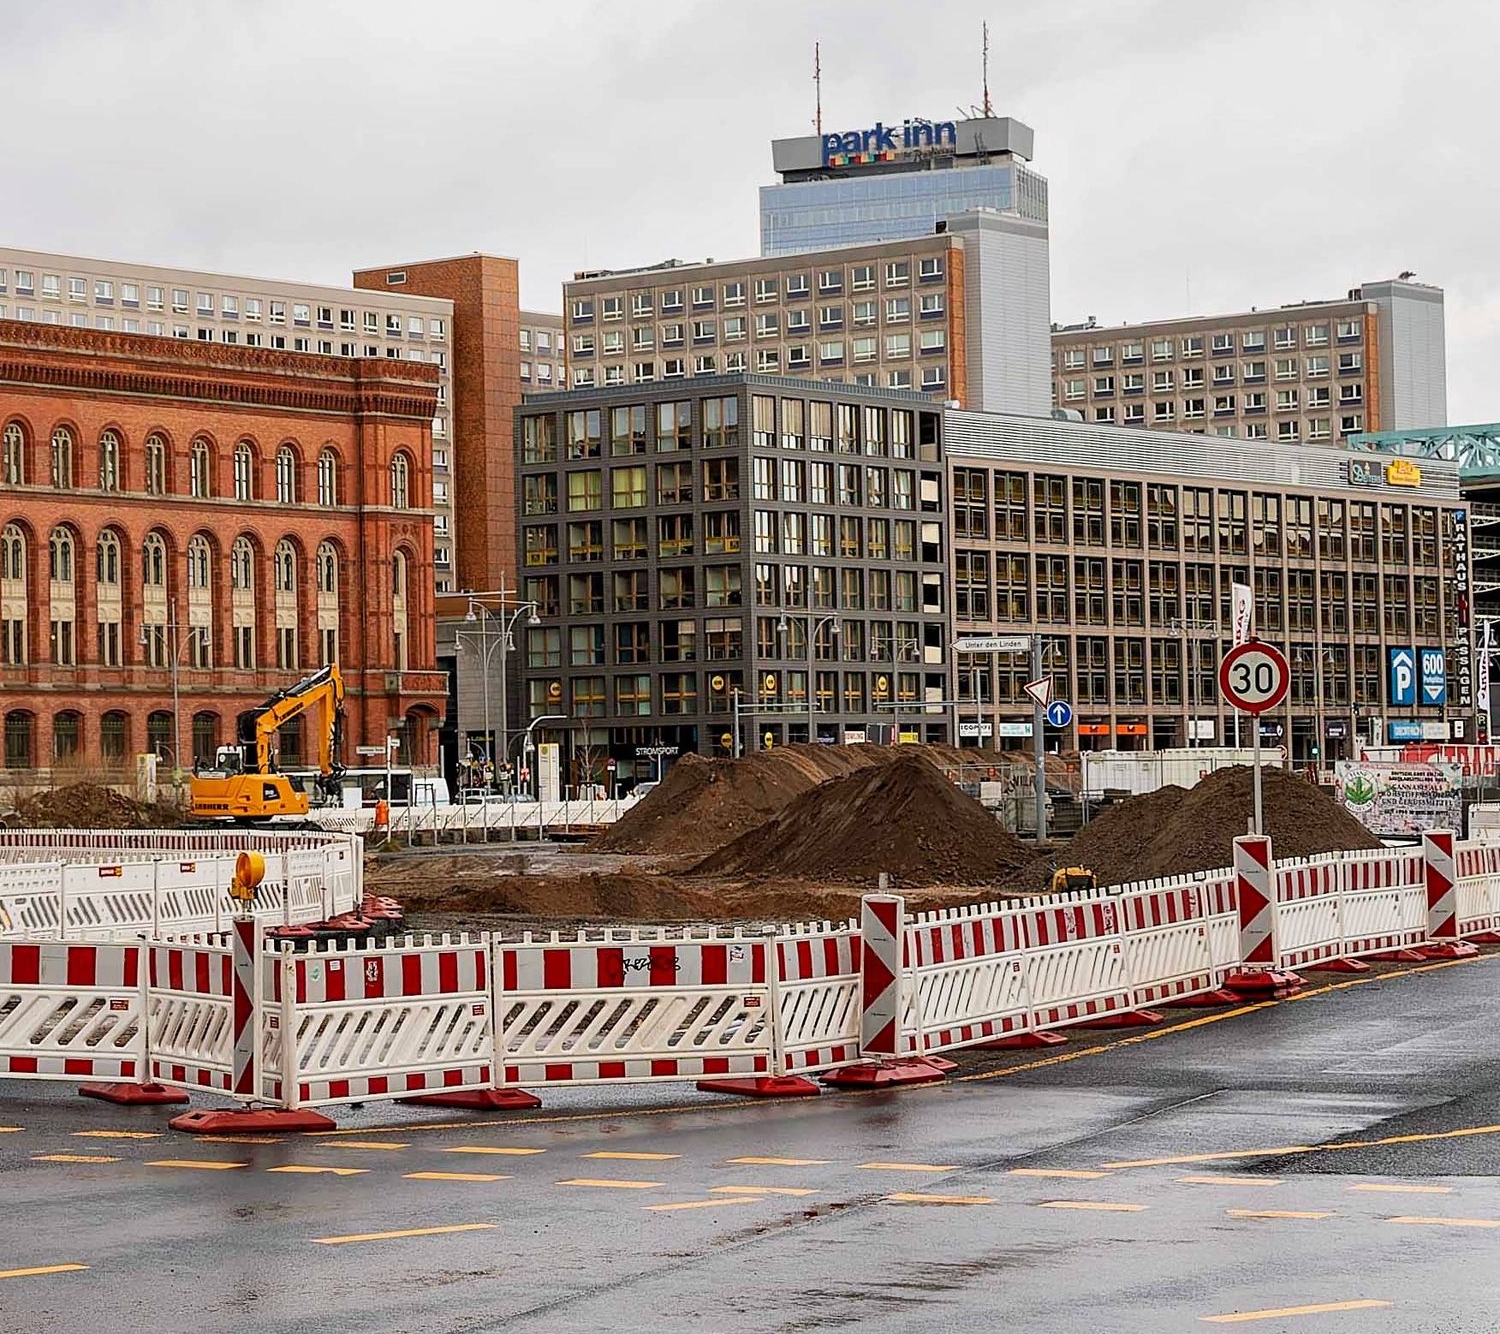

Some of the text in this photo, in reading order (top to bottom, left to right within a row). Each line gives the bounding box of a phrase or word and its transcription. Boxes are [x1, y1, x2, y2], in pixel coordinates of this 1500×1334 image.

[821, 122, 897, 167] park
[903, 120, 957, 148] inn
[1455, 523, 1471, 705] RATHAUS PASSAGEN
[965, 641, 983, 649] Unter
[999, 640, 1022, 648] Linden
[1232, 662, 1274, 695] 30
[1422, 653, 1444, 675] 600
[1396, 666, 1411, 701] P
[635, 746, 679, 756] STROMSPORT
